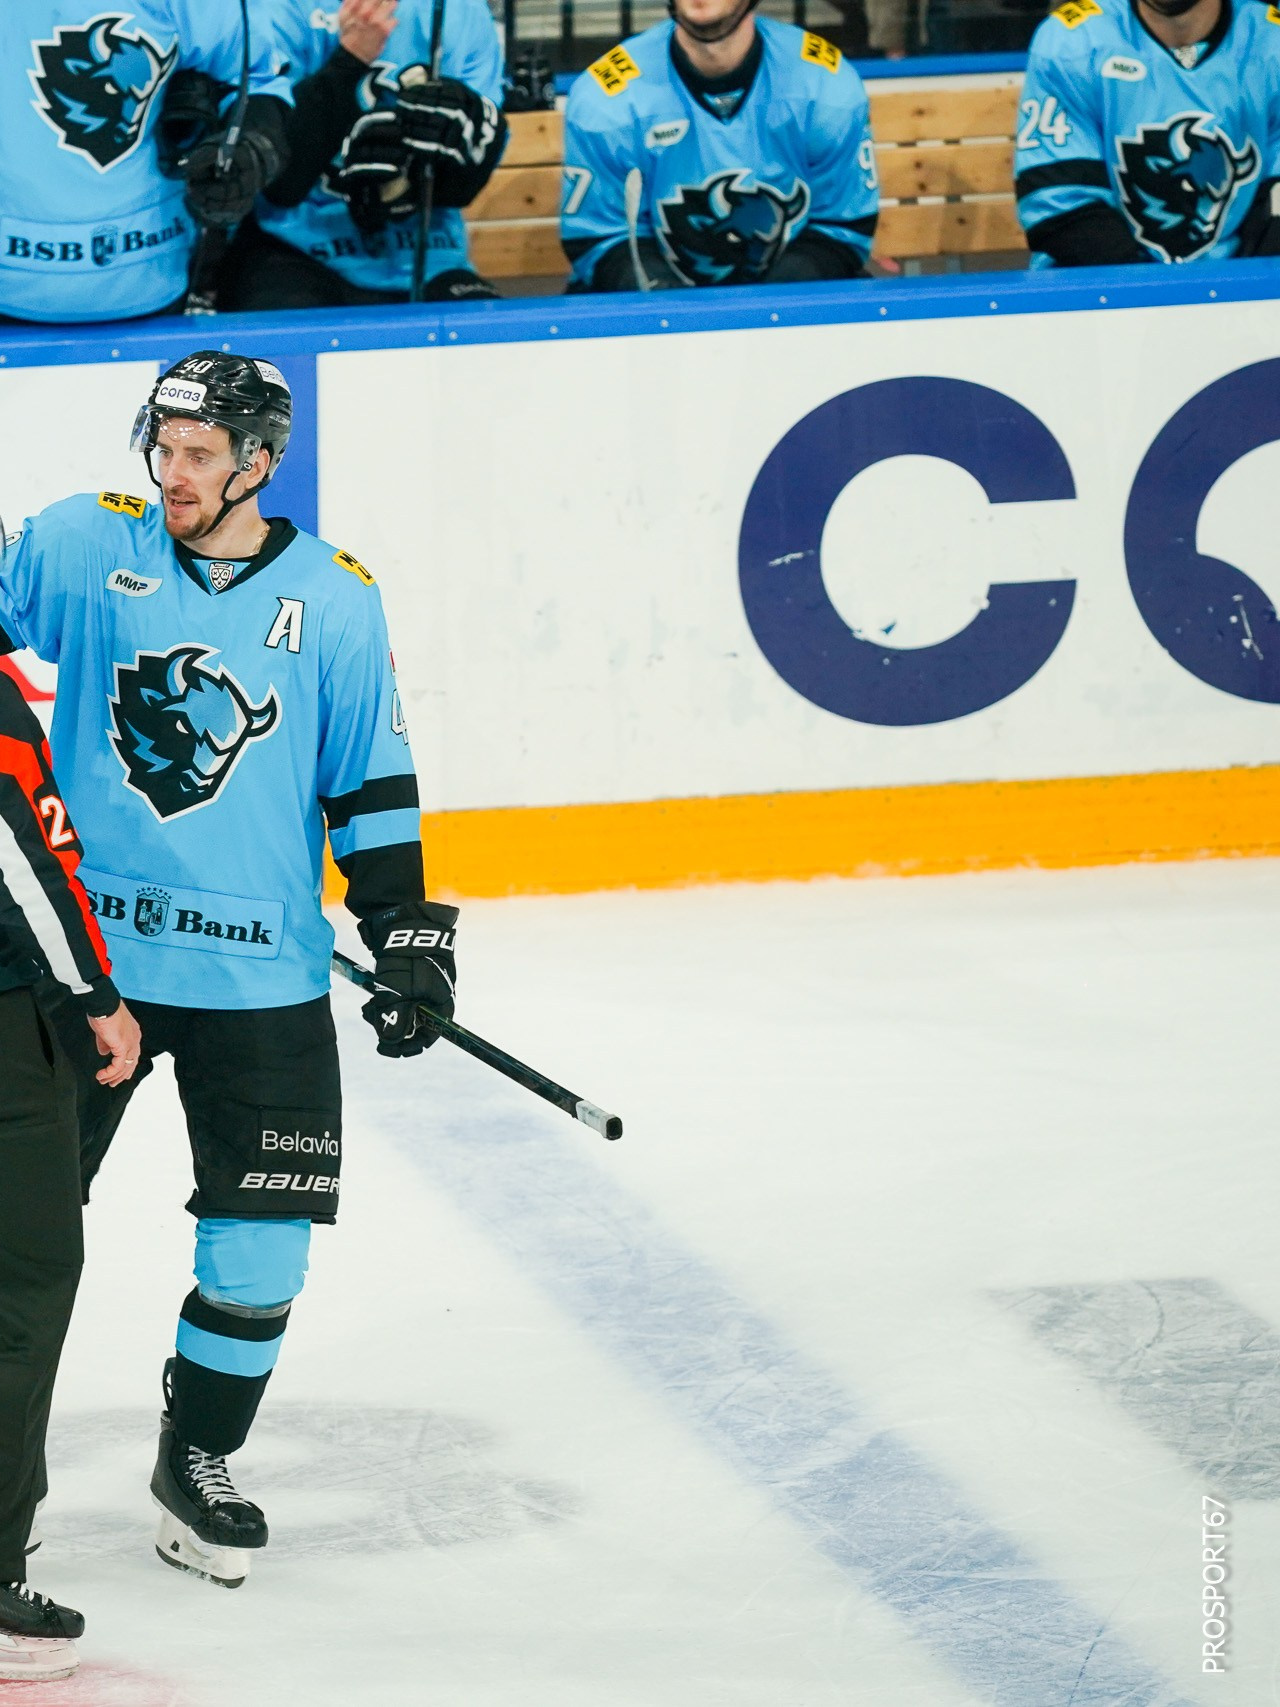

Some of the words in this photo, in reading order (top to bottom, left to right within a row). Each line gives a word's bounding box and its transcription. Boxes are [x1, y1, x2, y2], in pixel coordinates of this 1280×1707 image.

[1019, 96, 1072, 150] 24
[6, 235, 84, 262] BSB
[122, 216, 187, 254] Bank
[183, 358, 215, 374] 40
[160, 386, 201, 402] согаз
[115, 573, 149, 592] МИР
[264, 596, 306, 655] A
[39, 794, 75, 849] 2
[85, 889, 127, 922] SB
[171, 908, 274, 946] Bank
[261, 1129, 340, 1158] Belavia
